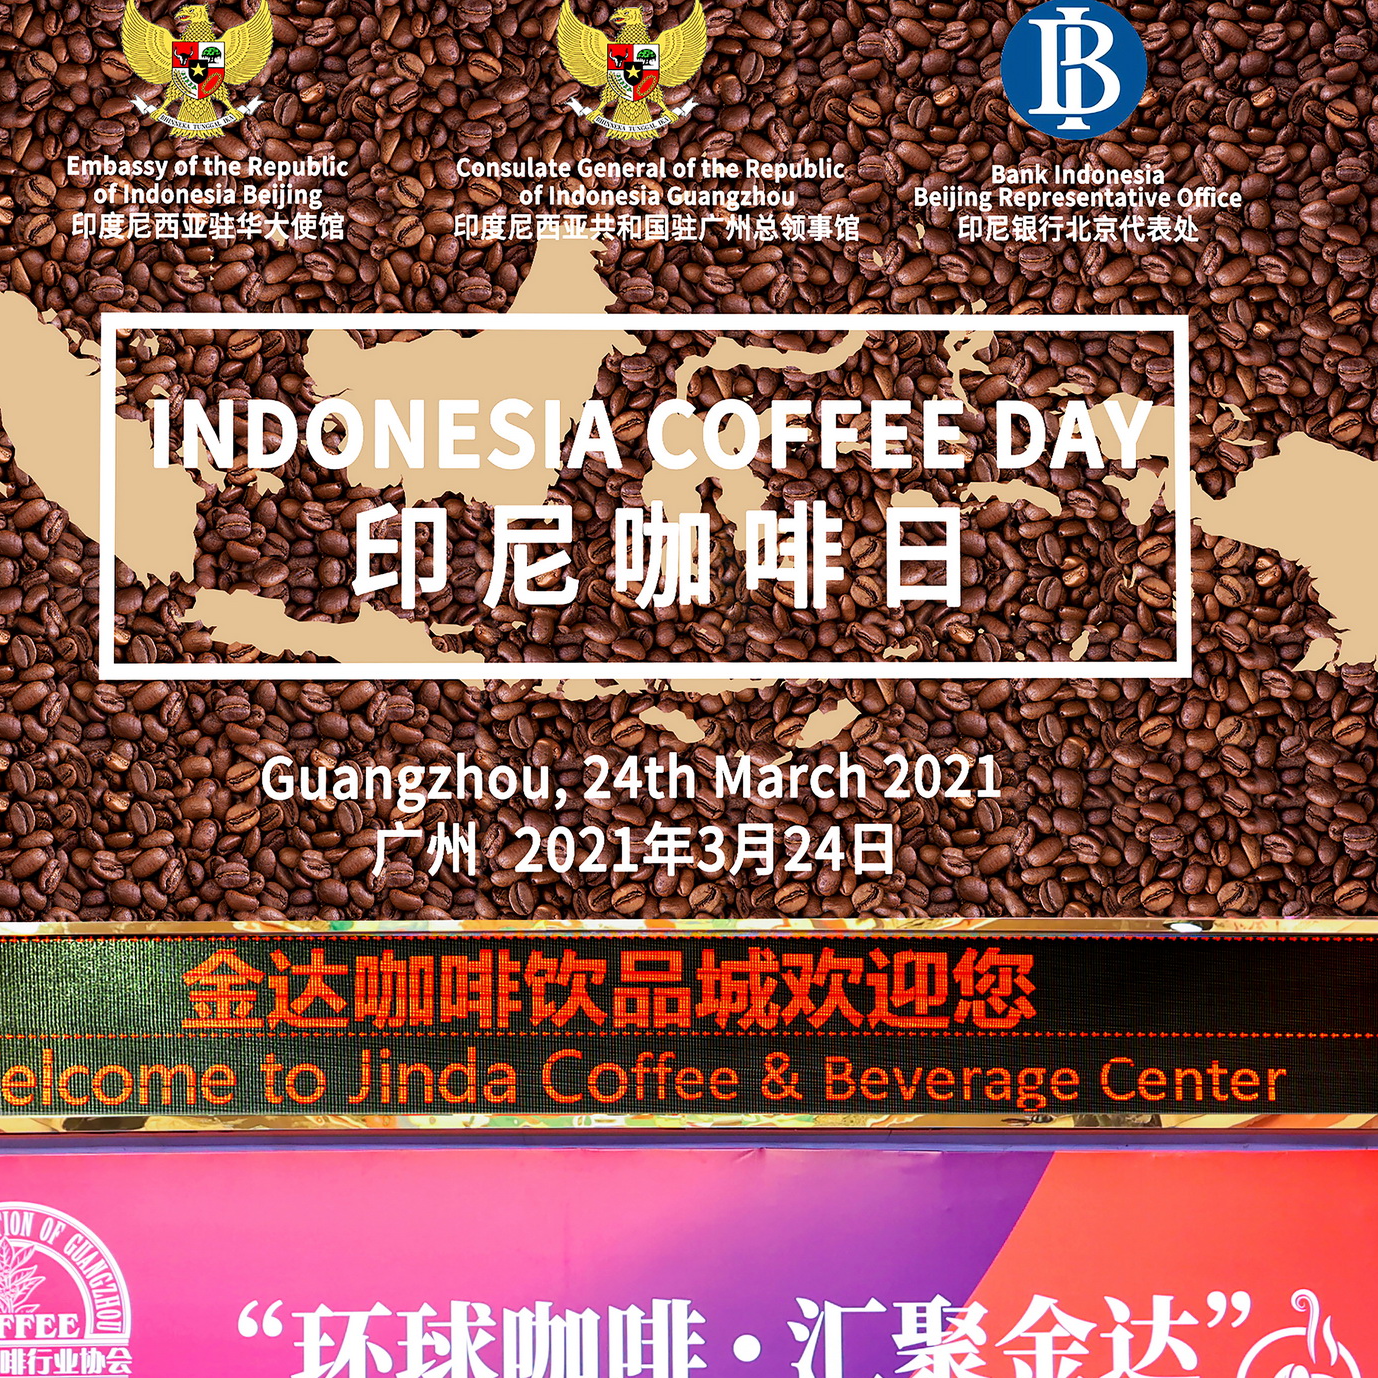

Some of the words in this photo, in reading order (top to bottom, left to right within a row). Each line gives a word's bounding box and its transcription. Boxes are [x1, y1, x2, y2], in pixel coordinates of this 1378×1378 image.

[67, 155, 168, 180] Embassy
[174, 155, 197, 176] of
[214, 156, 241, 176] the
[248, 155, 349, 180] Republic
[456, 157, 571, 178] Consulate
[576, 157, 667, 178] General
[671, 157, 697, 178] of
[702, 158, 739, 178] the
[747, 157, 845, 183] Republic
[991, 164, 1048, 185] Bank
[1054, 164, 1165, 185] Indonesia
[94, 184, 117, 205] of
[124, 184, 235, 205] Indonesia
[243, 184, 323, 210] Beijing
[520, 186, 543, 206] of
[549, 185, 661, 206] Indonesia
[667, 186, 795, 211] Guangzhou
[914, 187, 992, 212] Beijing
[999, 187, 1171, 212] Representative
[1177, 187, 1242, 208] Office
[72, 212, 345, 241] 印度尼西亚驻华大使馆
[454, 213, 860, 242] 印度尼西亚共和国驻广州总领事馆
[958, 215, 1200, 244] 印尼银行北京代表处
[152, 398, 624, 471] INDONESIA
[646, 398, 966, 471] COFFEE
[997, 399, 1154, 469] DAY
[352, 500, 962, 611] 印尼咖啡日
[262, 751, 567, 813] Guangzhou,
[584, 752, 696, 800] 24th
[714, 751, 867, 799] March
[883, 752, 1001, 799] 2021
[372, 821, 476, 877] 广州
[515, 820, 894, 877] 2021年3月24日
[180, 946, 1038, 1033] 金达咖啡饮品城欢迎您
[260, 1052, 326, 1105] to
[348, 1046, 517, 1105] Jinda
[541, 1048, 740, 1104] Coffee
[761, 1051, 803, 1101] &
[824, 1054, 1081, 1112] Beverage
[1100, 1056, 1287, 1103] Center
[39, 1217, 67, 1246] OF
[63, 1233, 123, 1333] GUANGZHOU
